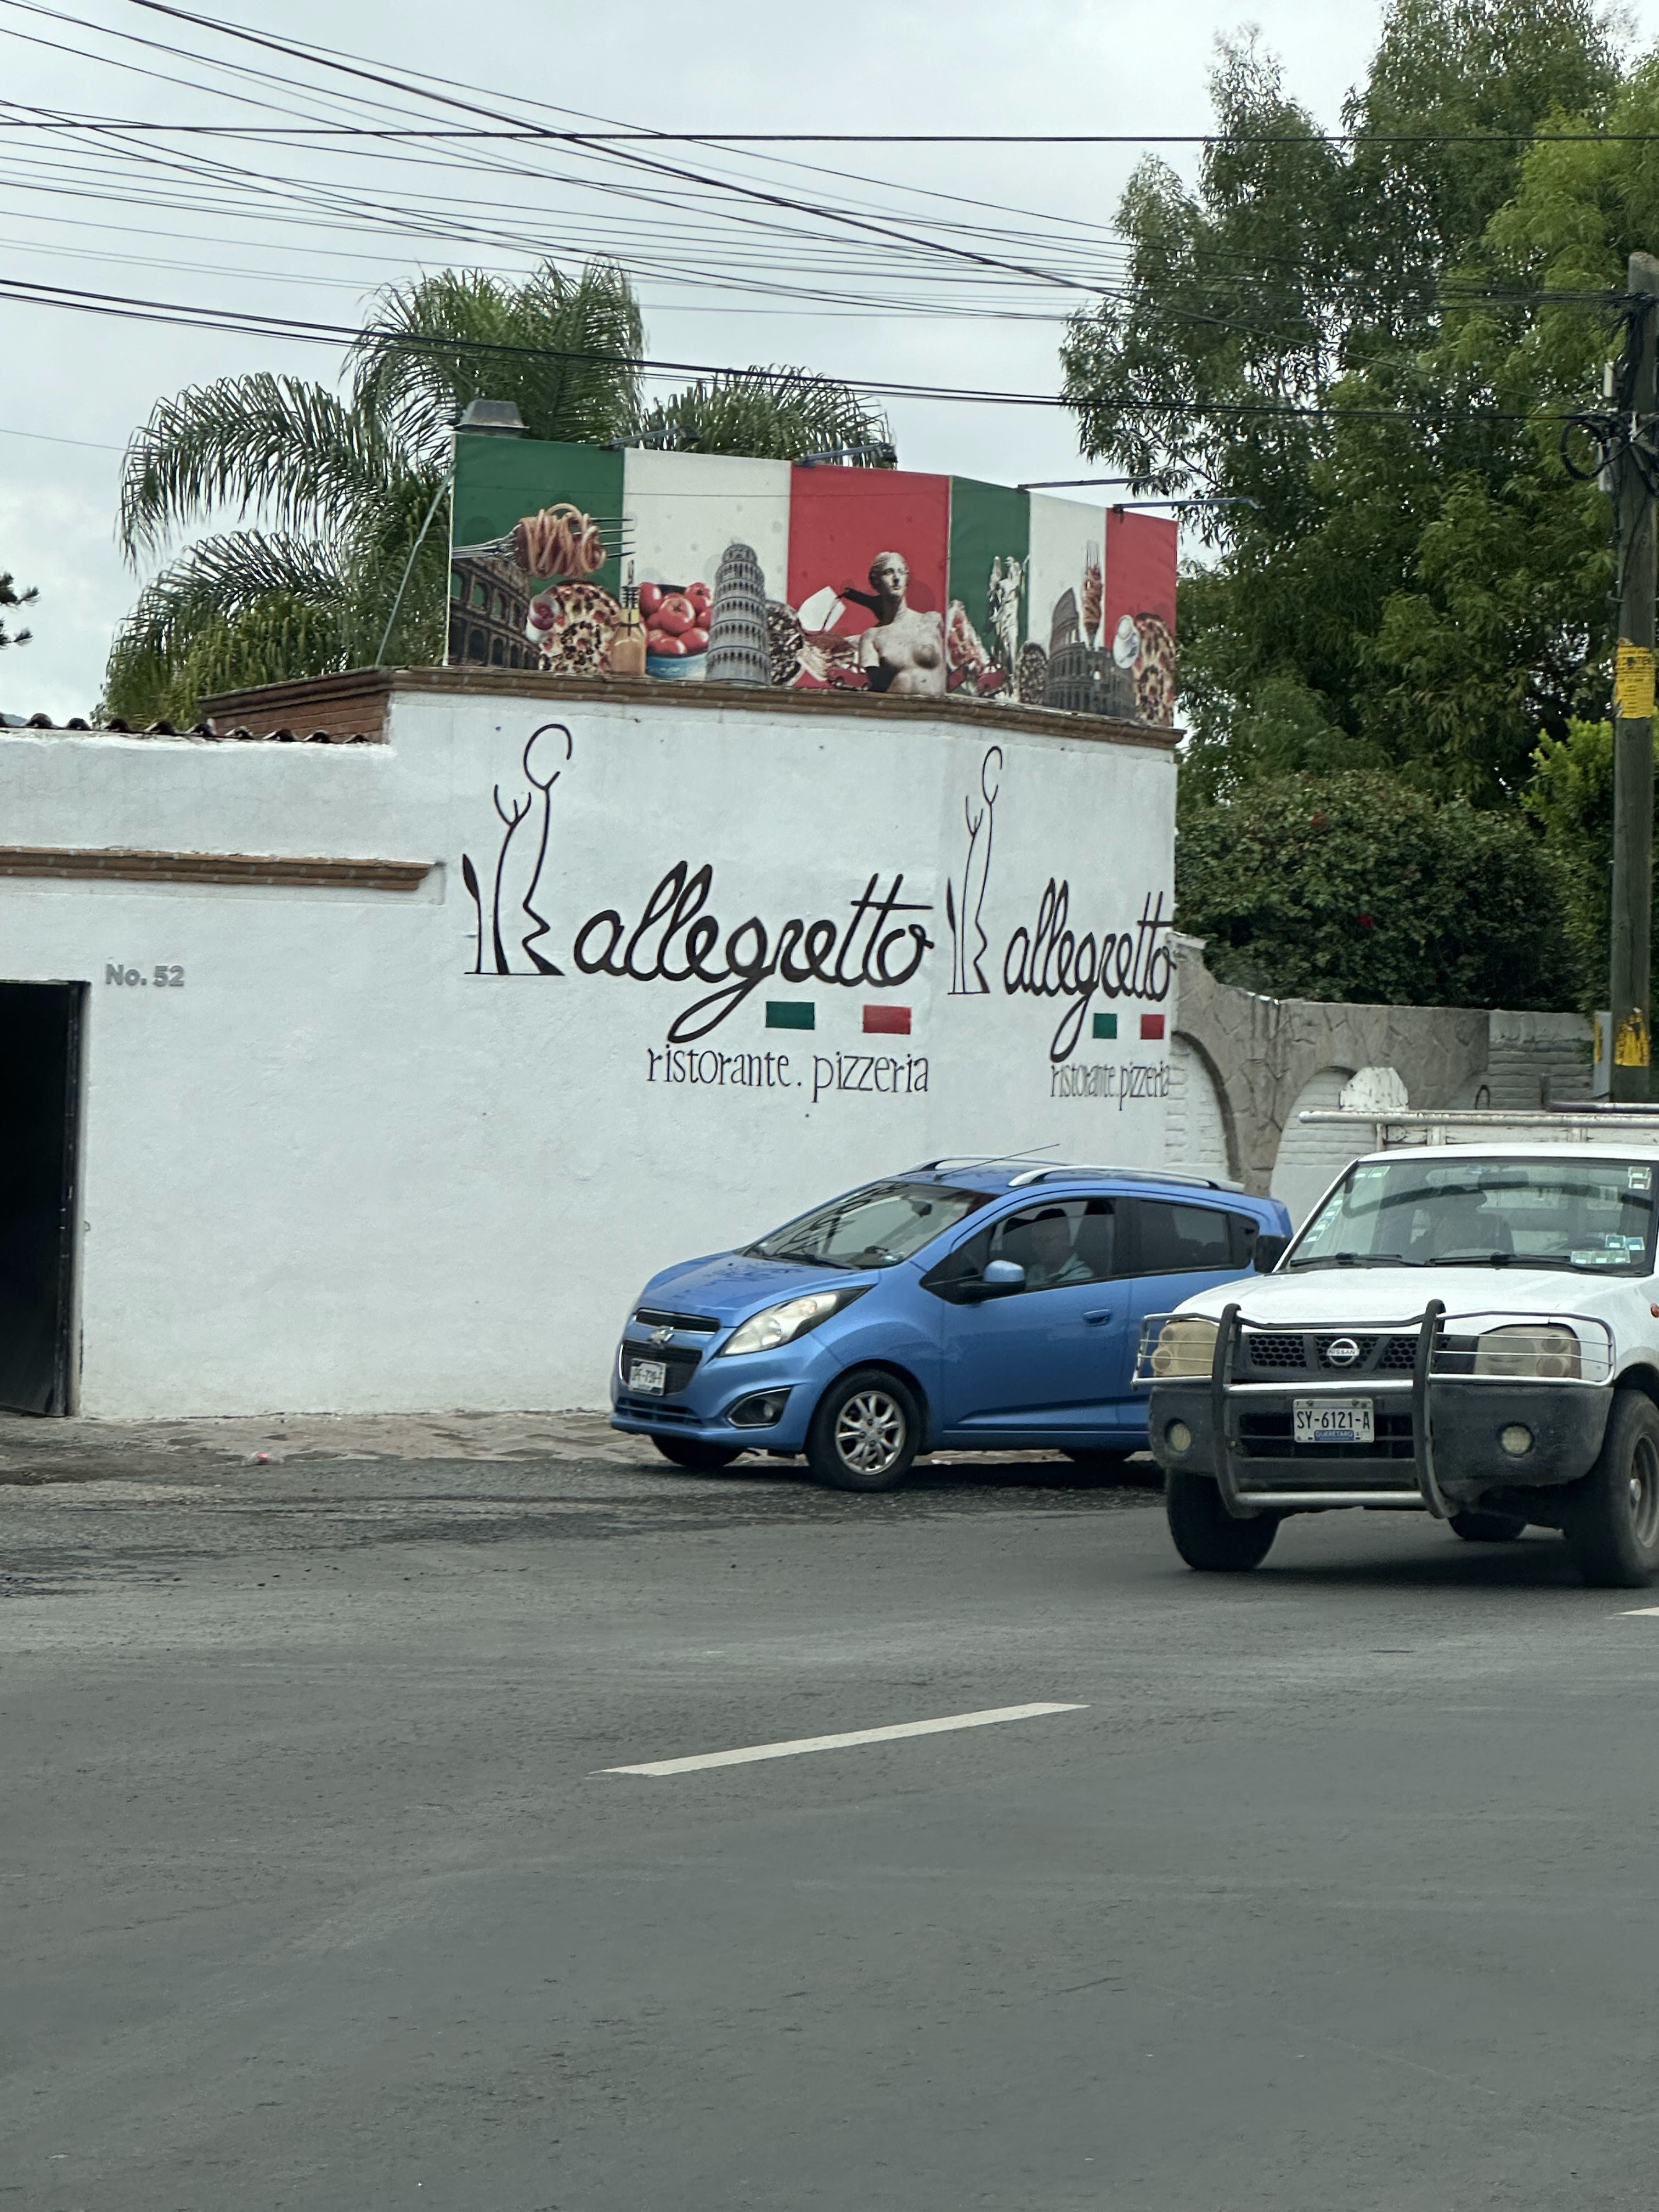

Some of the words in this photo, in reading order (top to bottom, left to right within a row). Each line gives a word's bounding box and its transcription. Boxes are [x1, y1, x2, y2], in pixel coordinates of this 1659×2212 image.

[105, 963, 147, 986] No.
[153, 965, 185, 987] 52
[573, 860, 934, 1043] allegretto
[1004, 878, 1177, 1063] allegretto
[812, 1051, 930, 1103] pizzeria
[1296, 1410, 1370, 1430] SY-6121-A
